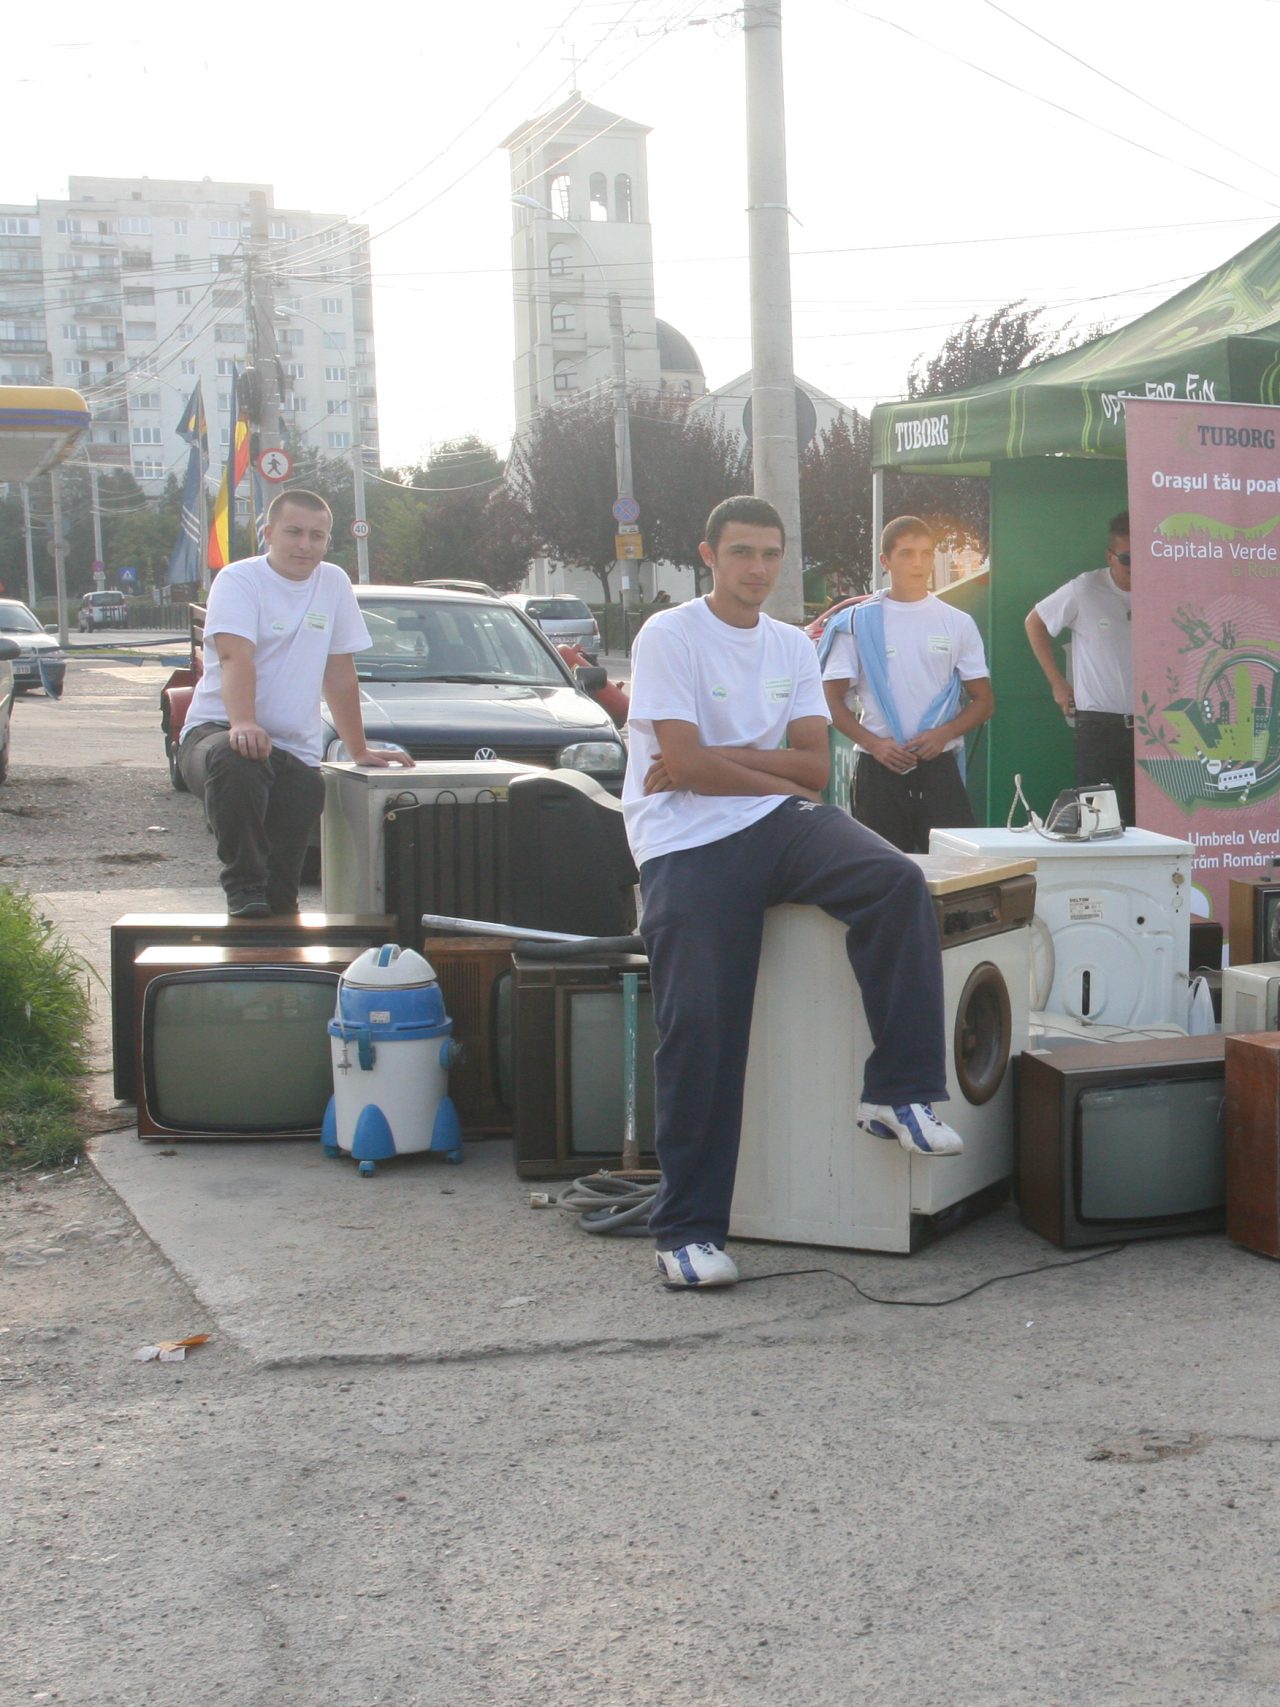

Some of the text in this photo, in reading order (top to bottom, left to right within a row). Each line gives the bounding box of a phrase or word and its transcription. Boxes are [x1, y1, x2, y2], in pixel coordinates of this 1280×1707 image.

[895, 415, 949, 452] TUBORG
[1197, 425, 1276, 449] TUBORG
[1213, 473, 1241, 492] tău
[355, 524, 367, 534] 40
[1150, 541, 1277, 562] Capitala Verde
[1231, 565, 1241, 577] a
[1188, 830, 1245, 847] Umbrela
